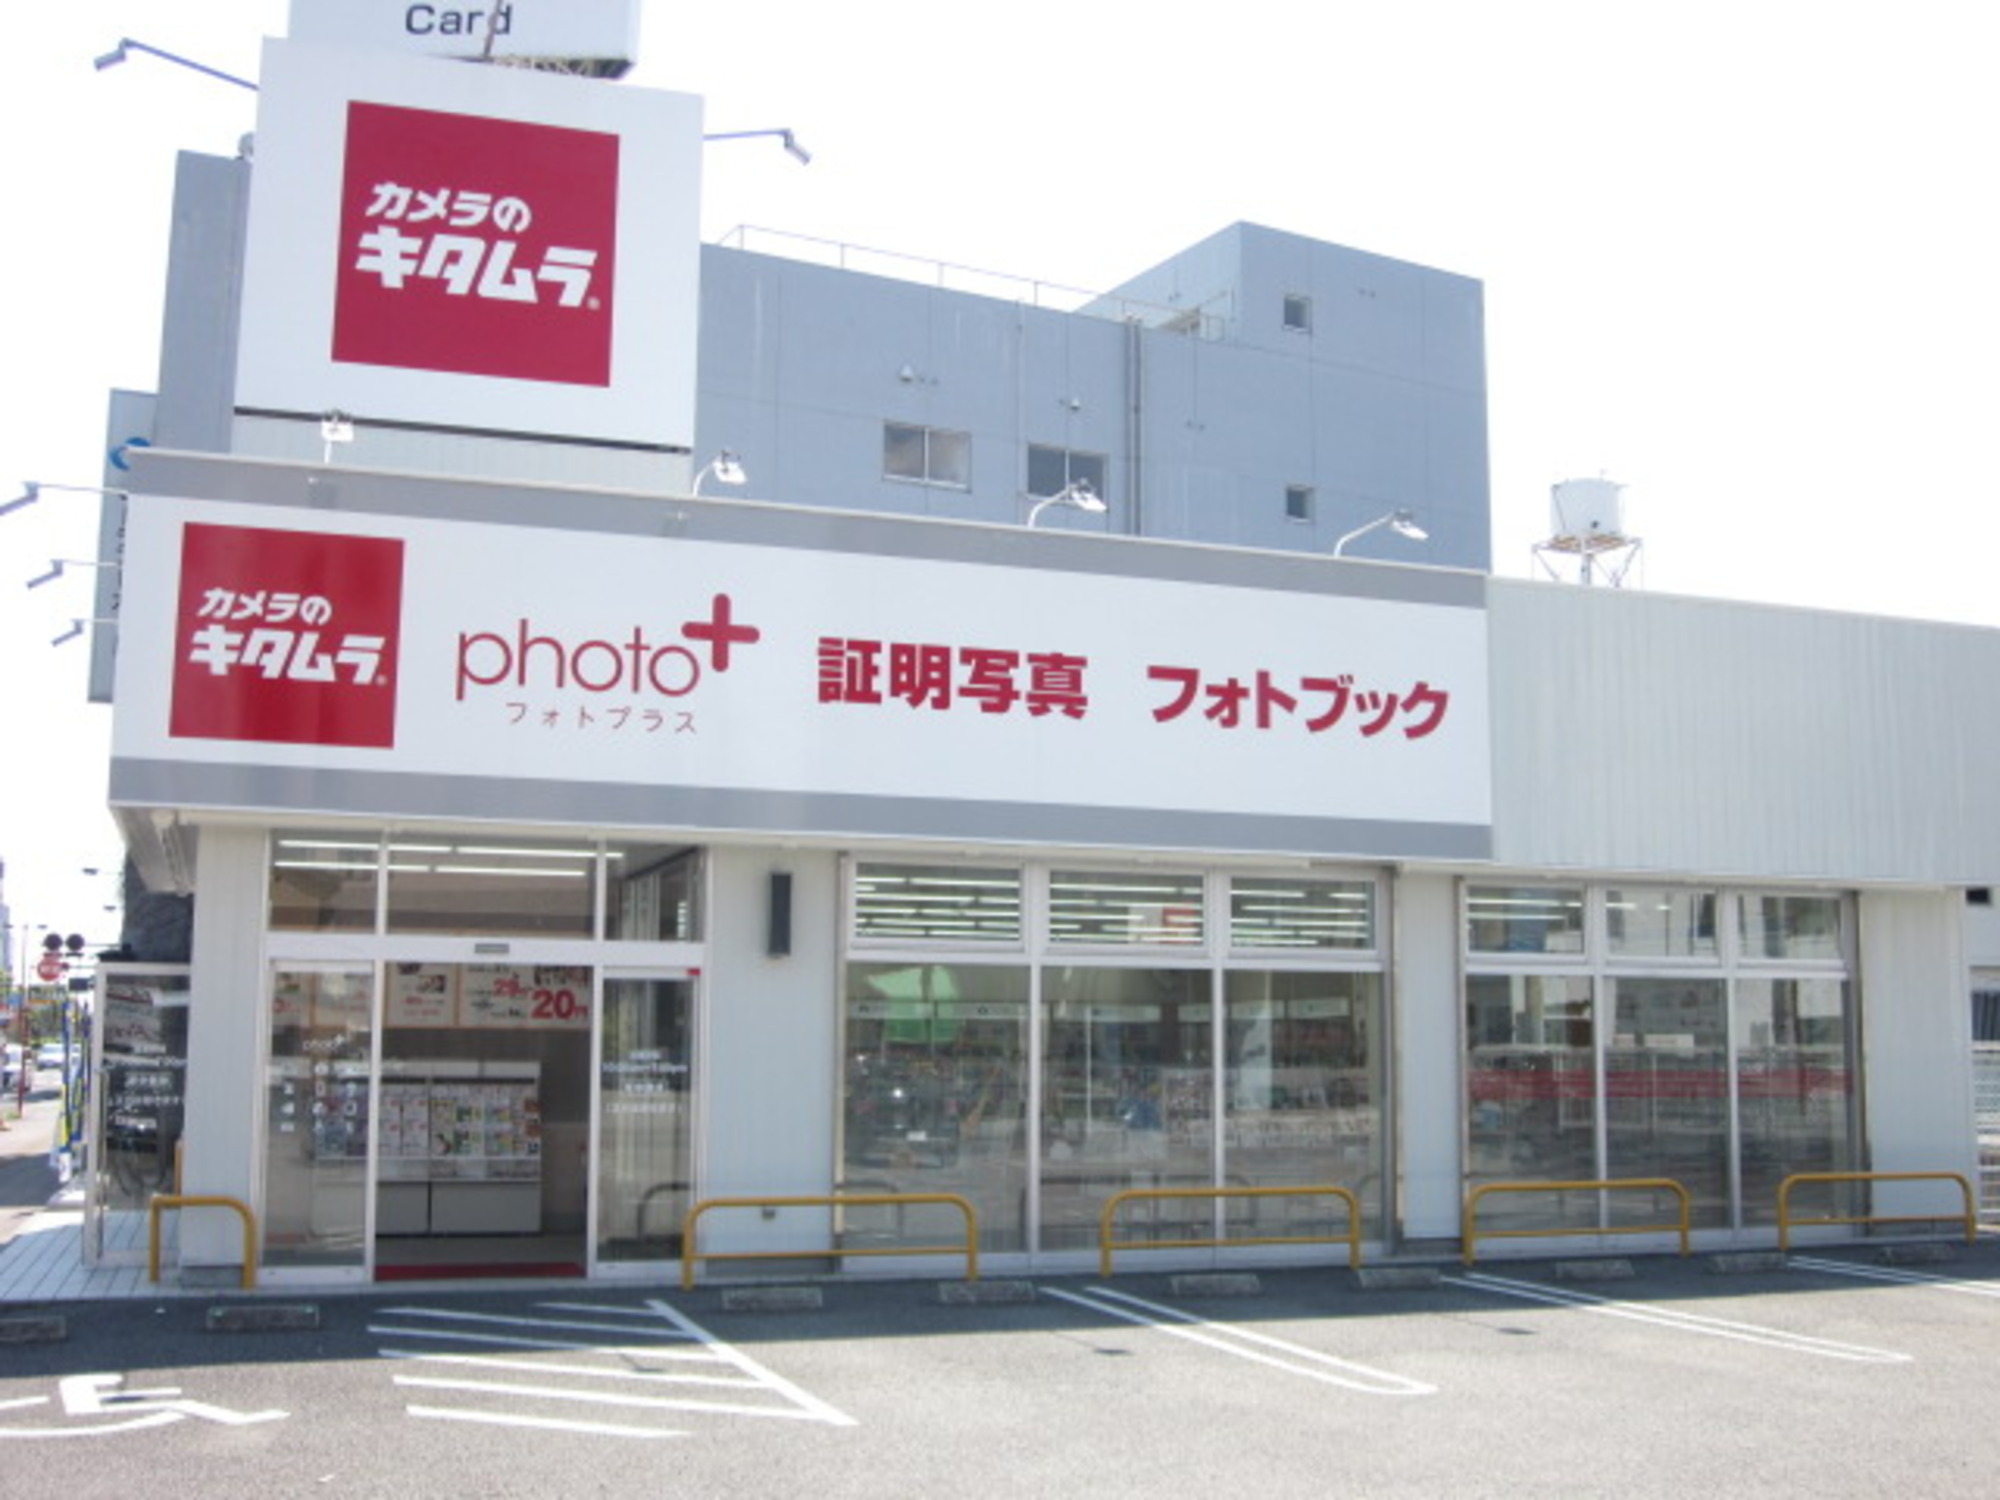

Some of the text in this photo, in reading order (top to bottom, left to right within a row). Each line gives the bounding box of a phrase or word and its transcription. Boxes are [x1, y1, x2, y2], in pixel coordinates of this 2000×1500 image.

[405, 4, 512, 35] Card
[364, 183, 532, 234] カメラの
[354, 225, 598, 308] キタムラ
[197, 588, 332, 625] カメラの
[189, 624, 386, 685] キタムラ
[816, 636, 1449, 739] 証明写真 フォトブック
[505, 701, 698, 734] フォトプラス
